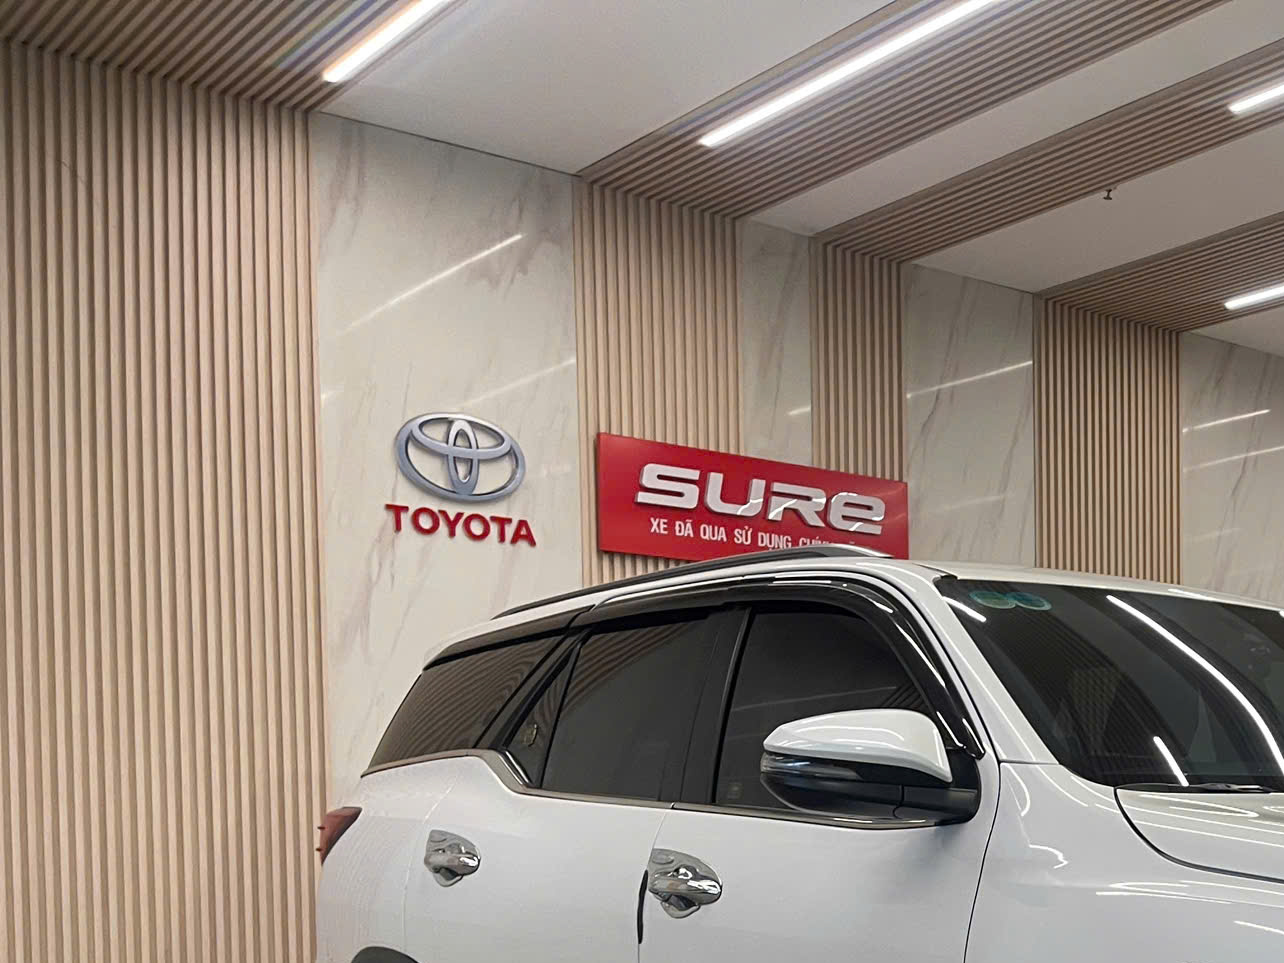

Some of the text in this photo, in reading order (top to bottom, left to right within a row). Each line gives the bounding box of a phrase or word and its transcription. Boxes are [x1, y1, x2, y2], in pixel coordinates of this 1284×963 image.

[385, 503, 537, 547] TOYOTA
[650, 517, 668, 535] XE
[675, 519, 694, 538] ĐÃ
[700, 523, 727, 543] QUA
[734, 525, 753, 545] SỬ
[757, 532, 792, 550] DỤNG
